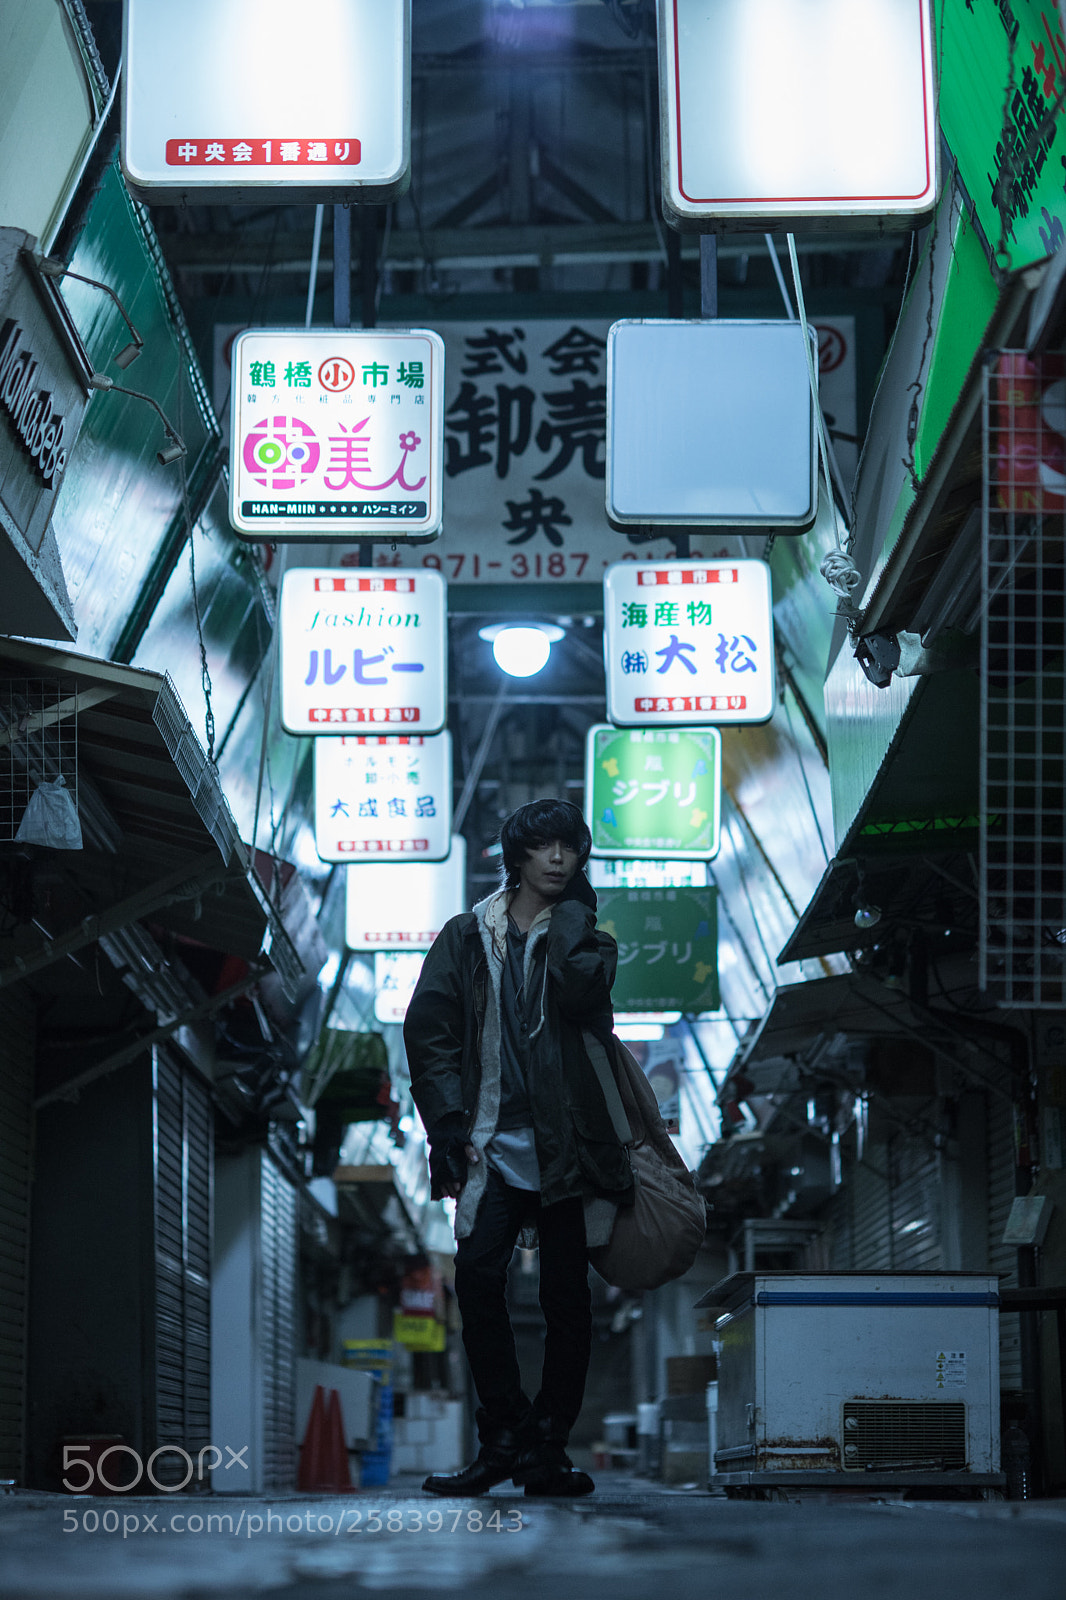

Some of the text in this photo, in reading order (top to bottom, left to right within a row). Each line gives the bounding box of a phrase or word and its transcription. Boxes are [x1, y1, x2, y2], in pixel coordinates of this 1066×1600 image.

[177, 140, 352, 163] 中央会1番通り
[461, 326, 607, 377] 式会
[445, 379, 606, 481] 卸売
[252, 504, 316, 515] HAN-MIIN
[502, 488, 573, 547] 央
[305, 607, 421, 632] fashion
[621, 601, 713, 628] 海産物
[304, 645, 425, 686] ルビー
[655, 633, 758, 675] 大松
[330, 795, 437, 818] 大成食品
[612, 779, 697, 807] ジブリ
